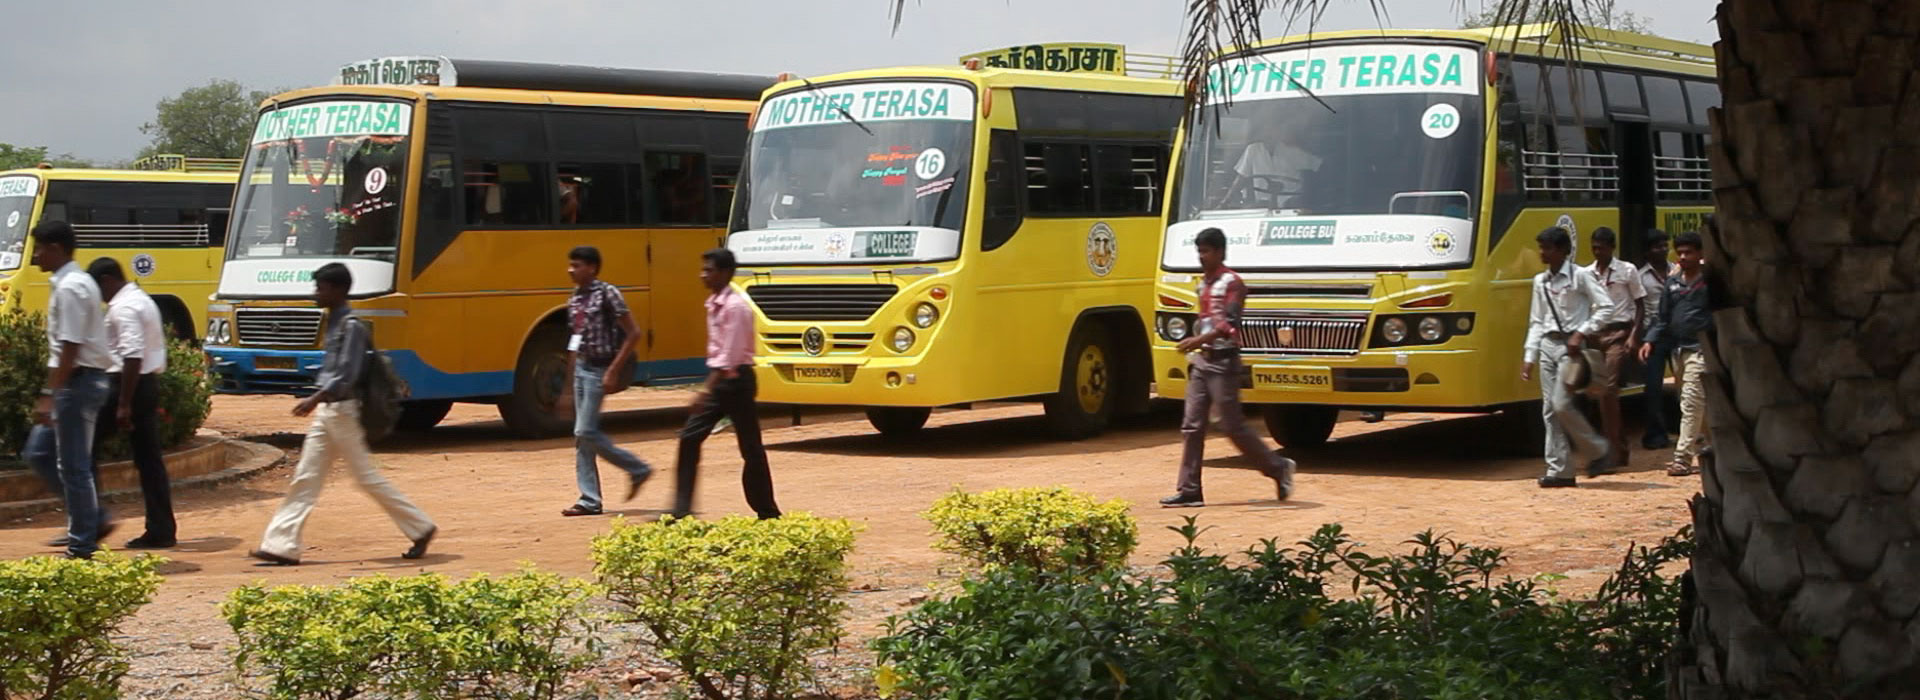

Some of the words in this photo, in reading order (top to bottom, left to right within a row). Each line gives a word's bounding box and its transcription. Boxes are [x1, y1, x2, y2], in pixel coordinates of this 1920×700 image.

[1207, 58, 1327, 98] MOTHER
[1338, 53, 1462, 88] TERASA
[766, 93, 856, 126] MOTHER
[861, 88, 949, 119] TERASA
[255, 107, 321, 140] MOTHER
[326, 103, 401, 134] TERASA
[1429, 112, 1455, 129] 20
[920, 153, 941, 175] 16
[369, 169, 382, 192] 9
[871, 232, 910, 254] COLLEGE
[1271, 225, 1318, 239] COLLEGE
[256, 270, 296, 283] COLLEGE
